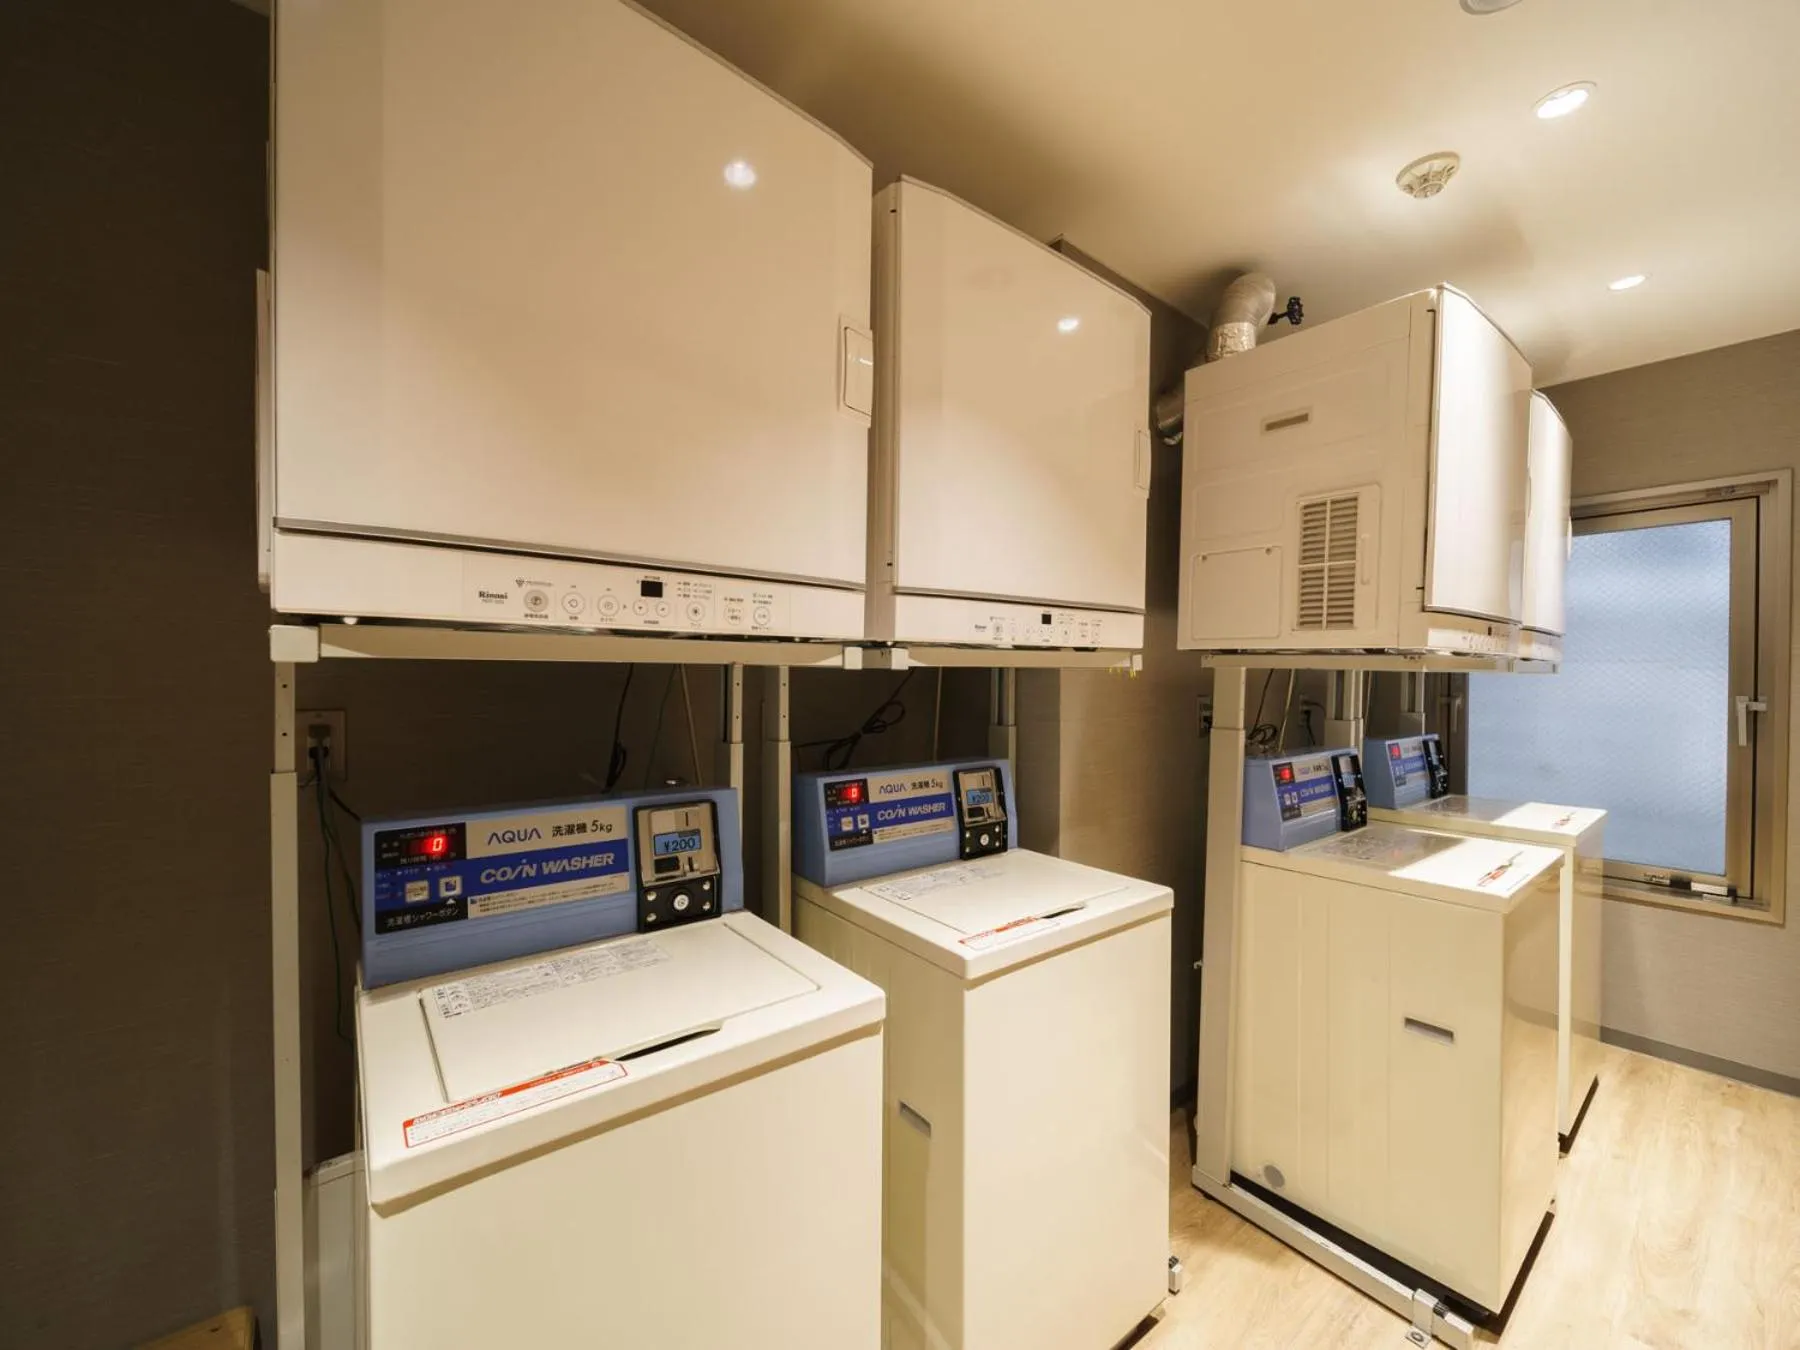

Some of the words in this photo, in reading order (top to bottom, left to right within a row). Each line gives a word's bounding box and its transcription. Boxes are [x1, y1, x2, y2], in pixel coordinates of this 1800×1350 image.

[879, 784, 908, 794] AQUA
[877, 801, 906, 821] COIN
[908, 802, 946, 817] WASHER
[487, 827, 542, 846] AQUA
[552, 822, 587, 838] 洗濯機
[591, 819, 613, 834] 5kg
[433, 837, 444, 852] 0
[664, 837, 696, 853] ¥200
[480, 859, 537, 884] COIN
[541, 852, 616, 875] WASHER
